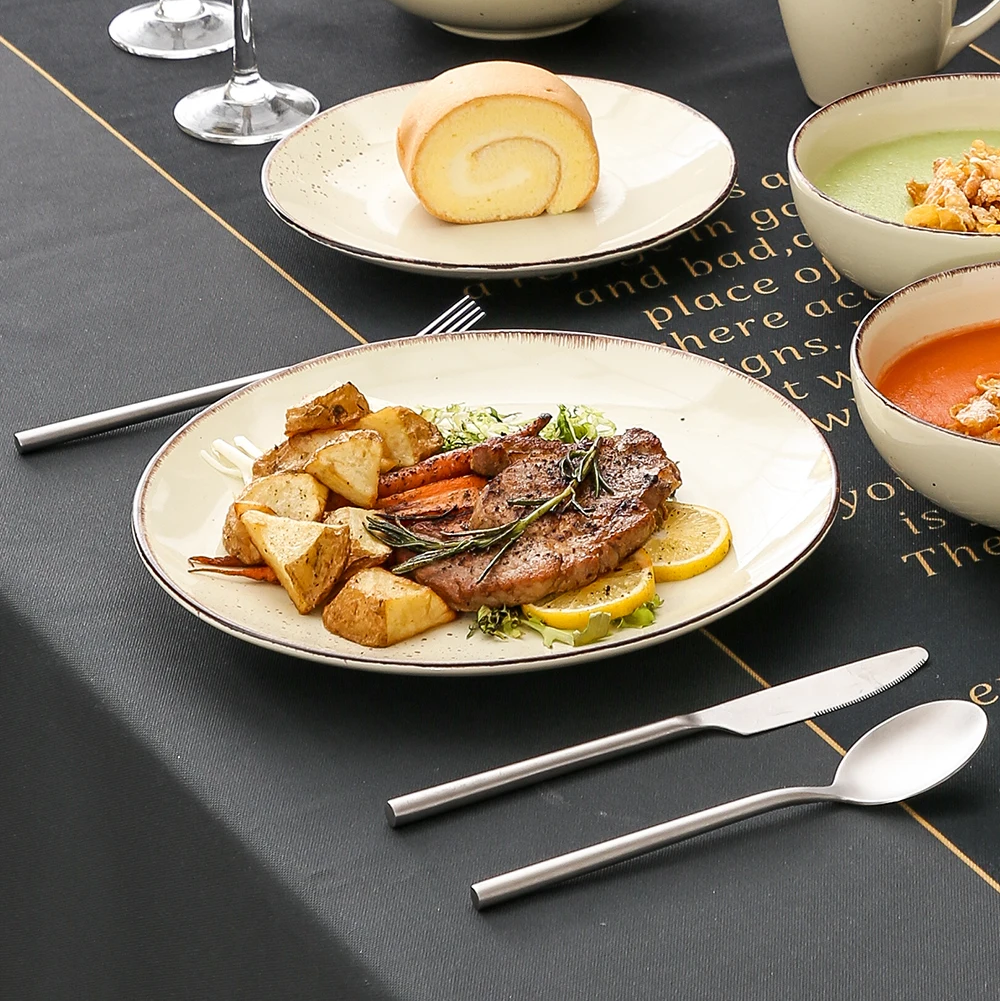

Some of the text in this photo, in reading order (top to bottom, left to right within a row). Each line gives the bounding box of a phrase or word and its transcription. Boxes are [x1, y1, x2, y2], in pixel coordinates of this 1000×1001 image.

[575, 265, 669, 306] and
[643, 277, 779, 330] place
[669, 310, 789, 351] here
[719, 337, 841, 379] gns.
[900, 512, 946, 535] is
